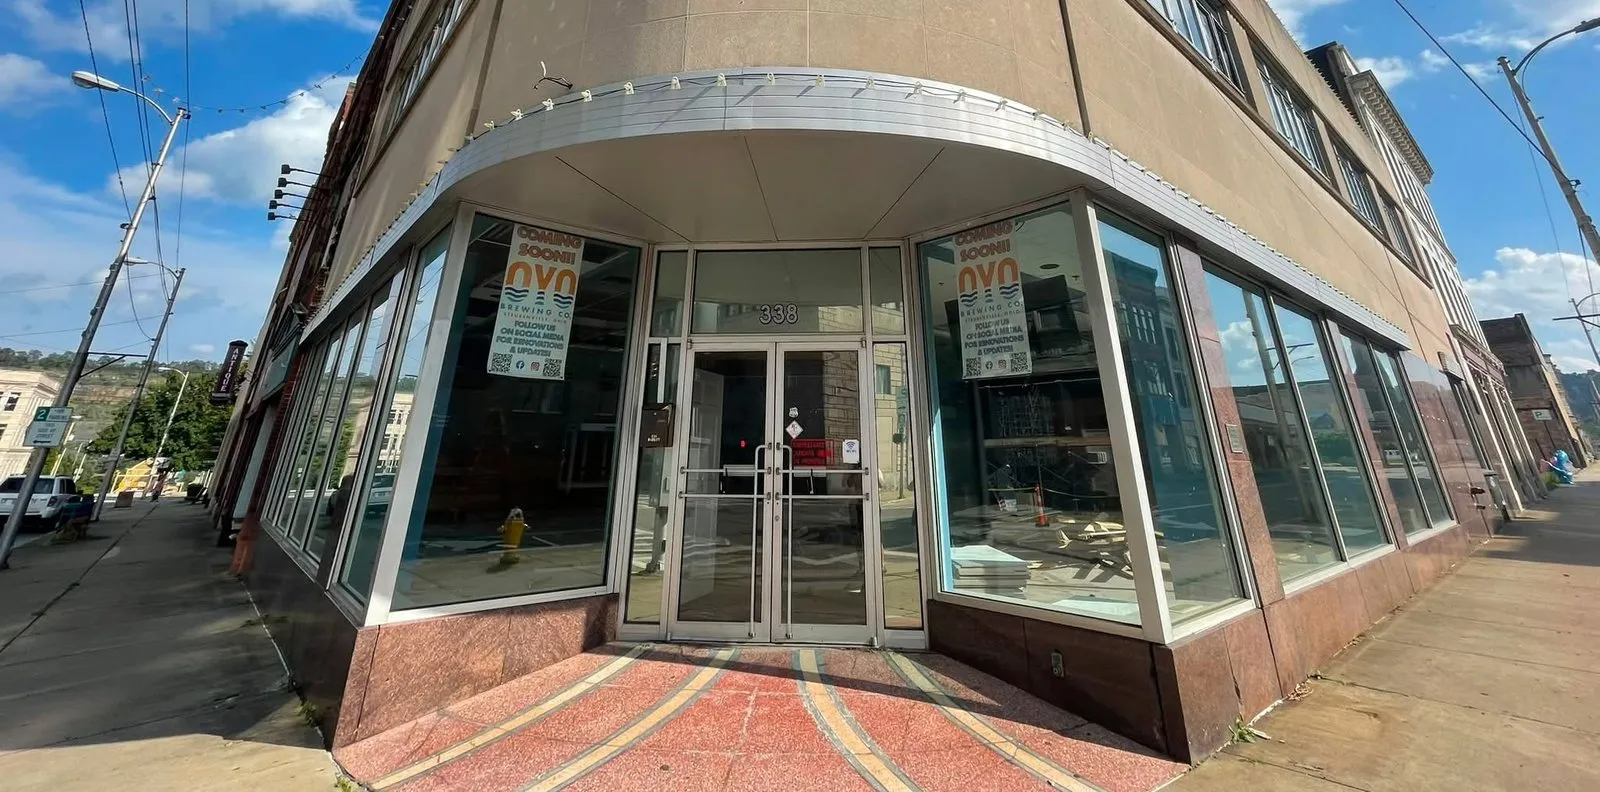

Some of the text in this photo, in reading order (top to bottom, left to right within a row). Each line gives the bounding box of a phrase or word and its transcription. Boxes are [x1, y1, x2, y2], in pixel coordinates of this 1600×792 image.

[518, 226, 582, 250] COMING
[954, 220, 1012, 246] COMING
[518, 244, 576, 264] SOON!!
[960, 240, 1010, 262] SOON!!
[502, 304, 552, 316] BREWING
[759, 303, 799, 324] 338
[960, 304, 1002, 316] BREWING
[516, 320, 546, 330] FOLLOW
[976, 320, 1000, 330] FOLLOW
[978, 330, 998, 338] SOCIAL
[1000, 326, 1022, 334] MEDIA
[500, 328, 564, 342] ON SOCIAL MEDIA
[978, 334, 1024, 348] RENOVATIONS
[496, 336, 564, 350] FOR RENOVATIONS
[220, 347, 239, 392] ANTIQUE
[36, 409, 47, 420] 2
